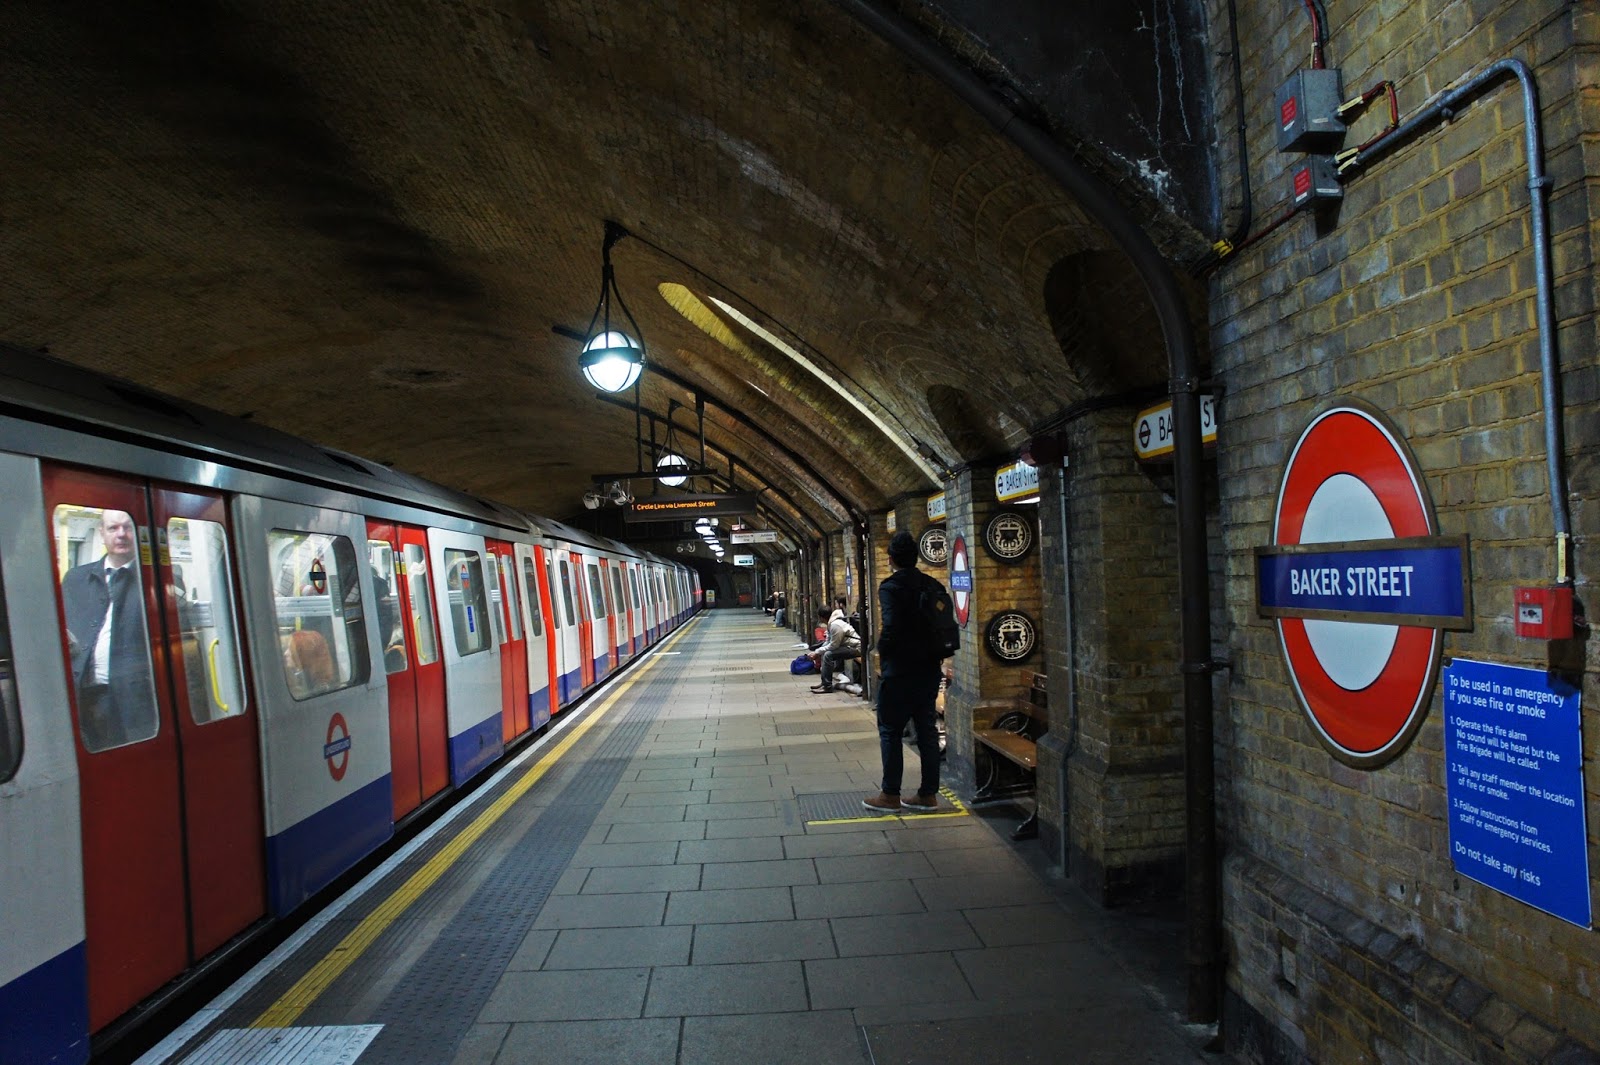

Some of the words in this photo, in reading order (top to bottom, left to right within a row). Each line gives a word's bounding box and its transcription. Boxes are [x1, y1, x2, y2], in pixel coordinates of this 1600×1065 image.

[960, 576, 969, 586] STREET
[1290, 568, 1342, 596] BAKER
[1347, 566, 1414, 596] STREET
[1450, 675, 1458, 686] To
[1460, 677, 1470, 688] be
[1472, 680, 1490, 692] used
[1493, 682, 1500, 694] in
[1503, 686, 1512, 696] an
[1515, 689, 1564, 707] emergency
[1450, 690, 1455, 700] if
[1458, 693, 1471, 704] you
[1473, 696, 1487, 707] see
[1489, 697, 1503, 710] fire
[1506, 702, 1514, 712] or
[1518, 705, 1546, 719] smoke
[1450, 716, 1455, 724] 1.
[1456, 717, 1481, 731] Operate
[1482, 724, 1493, 734] the
[1495, 726, 1506, 736] fire
[1508, 730, 1527, 741] alarm
[1457, 729, 1466, 739] No
[1467, 733, 1485, 744] sound
[1487, 737, 1499, 747] will
[1500, 740, 1509, 750] be
[1511, 742, 1530, 754] heard
[1532, 746, 1544, 758] but
[1546, 751, 1560, 762] the
[1457, 741, 1468, 752] Fire
[1470, 744, 1492, 758] Brigade
[1494, 751, 1505, 761] will
[1507, 753, 1515, 764] be
[1518, 757, 1540, 770] called.
[1452, 763, 1457, 772] 2.
[1458, 764, 1468, 776] Tell
[1470, 769, 1480, 780] any
[1482, 773, 1498, 784] staff
[1500, 779, 1527, 793] member
[1529, 786, 1542, 797] the
[1543, 789, 1575, 807] location
[1458, 777, 1465, 786] of
[1467, 779, 1477, 790] fire
[1487, 787, 1510, 800] smoke.
[1460, 801, 1479, 815] Follow
[1480, 808, 1518, 828] instructions
[1521, 821, 1538, 835] from
[1460, 813, 1474, 824] staff
[1484, 823, 1519, 842] emergency
[1521, 836, 1553, 853] services.
[1456, 842, 1466, 855] Do
[1468, 849, 1481, 861] not
[1483, 854, 1501, 869] take
[1503, 863, 1517, 878] any
[1519, 869, 1541, 886] risks
